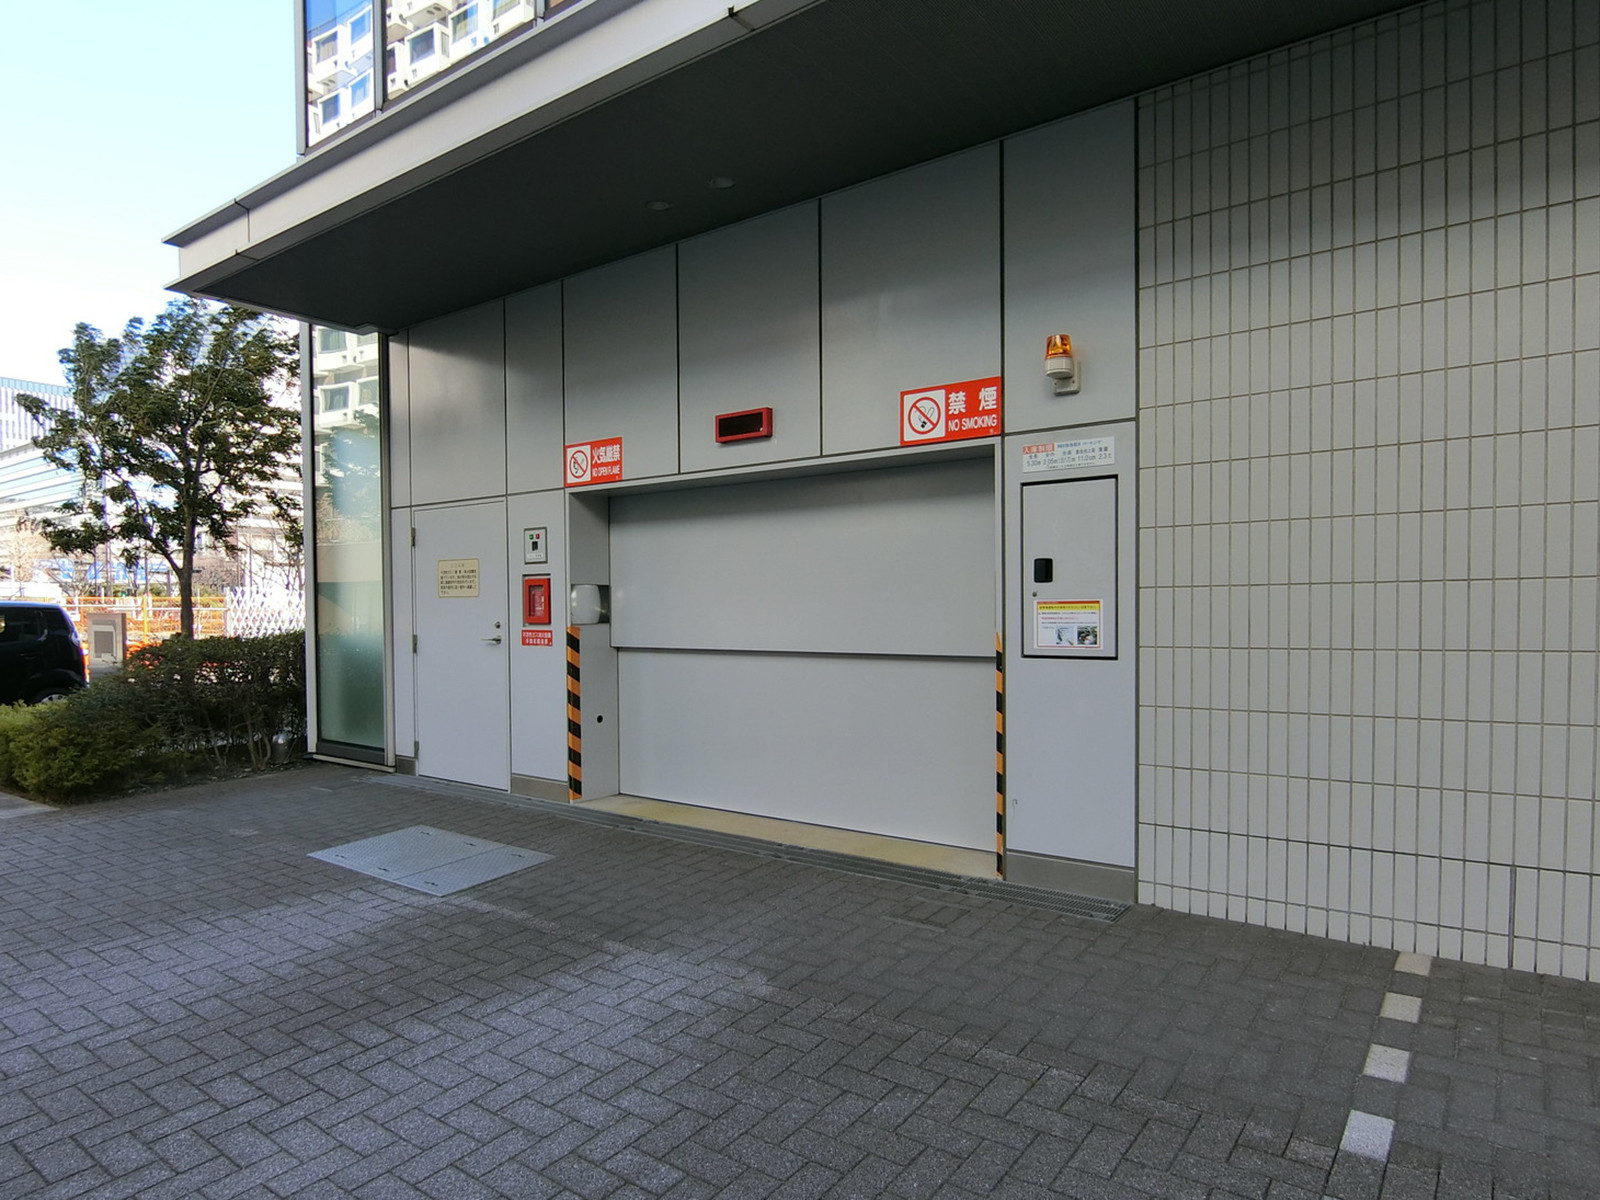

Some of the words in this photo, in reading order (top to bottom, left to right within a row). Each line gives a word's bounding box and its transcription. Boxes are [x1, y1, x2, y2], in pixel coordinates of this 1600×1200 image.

[948, 386, 997, 415] 禁煙
[948, 419, 960, 432] NO
[961, 414, 997, 431] SMOKING
